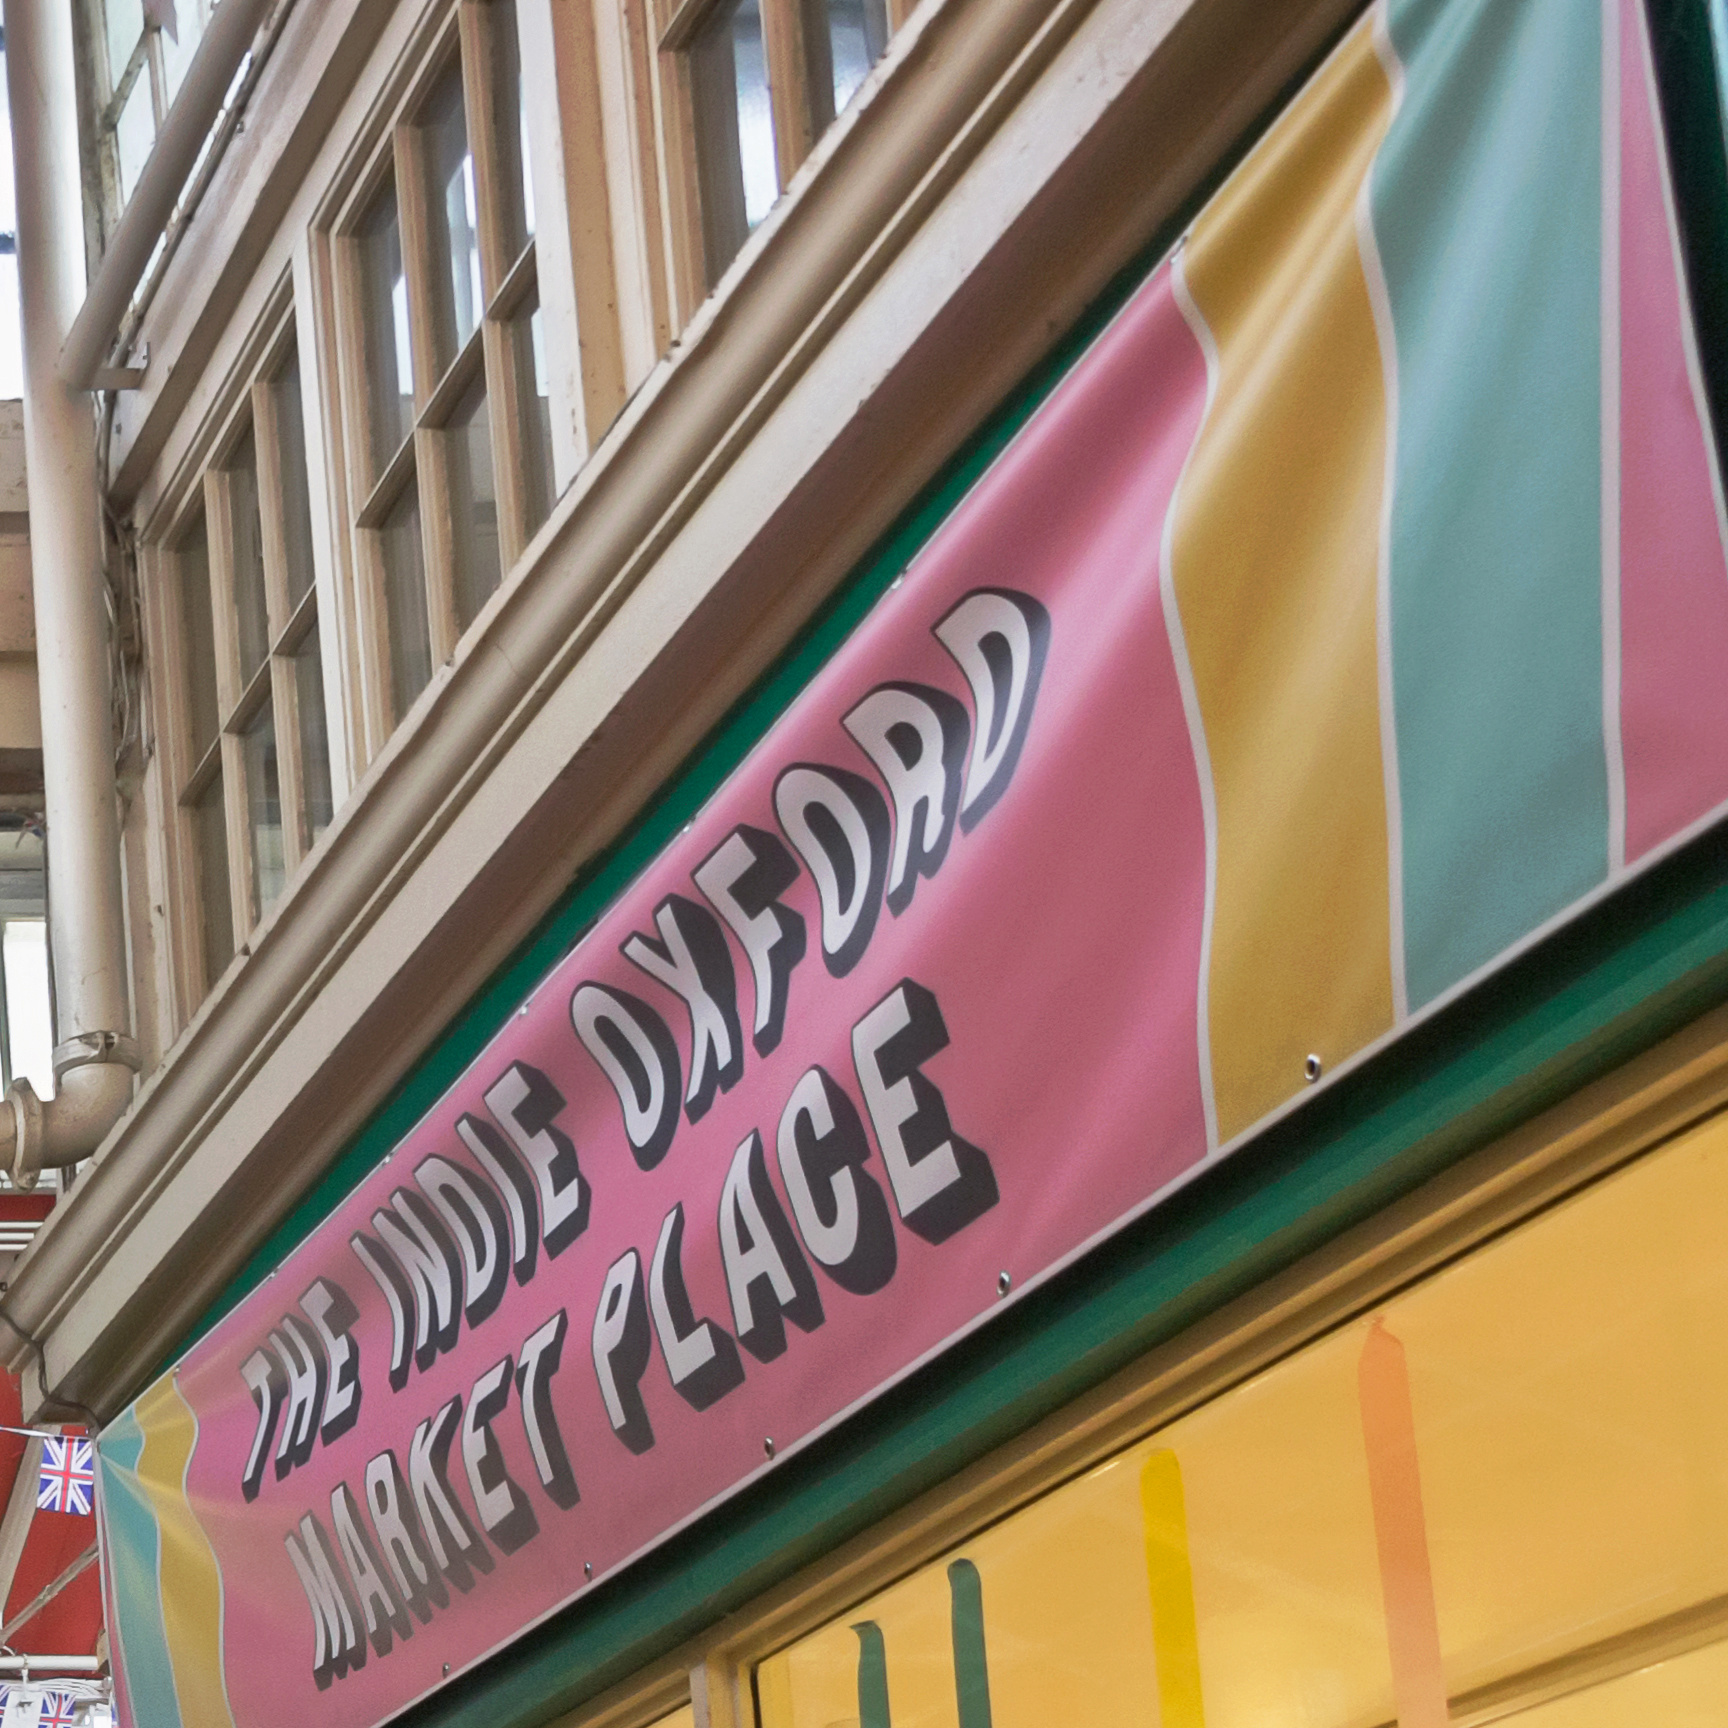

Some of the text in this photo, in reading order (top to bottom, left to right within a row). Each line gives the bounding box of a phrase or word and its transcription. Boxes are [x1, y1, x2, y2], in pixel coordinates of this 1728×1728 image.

[241, 584, 1052, 1503] THE INDIE OXFORD
[283, 976, 1000, 1692] MARKET PLACE
